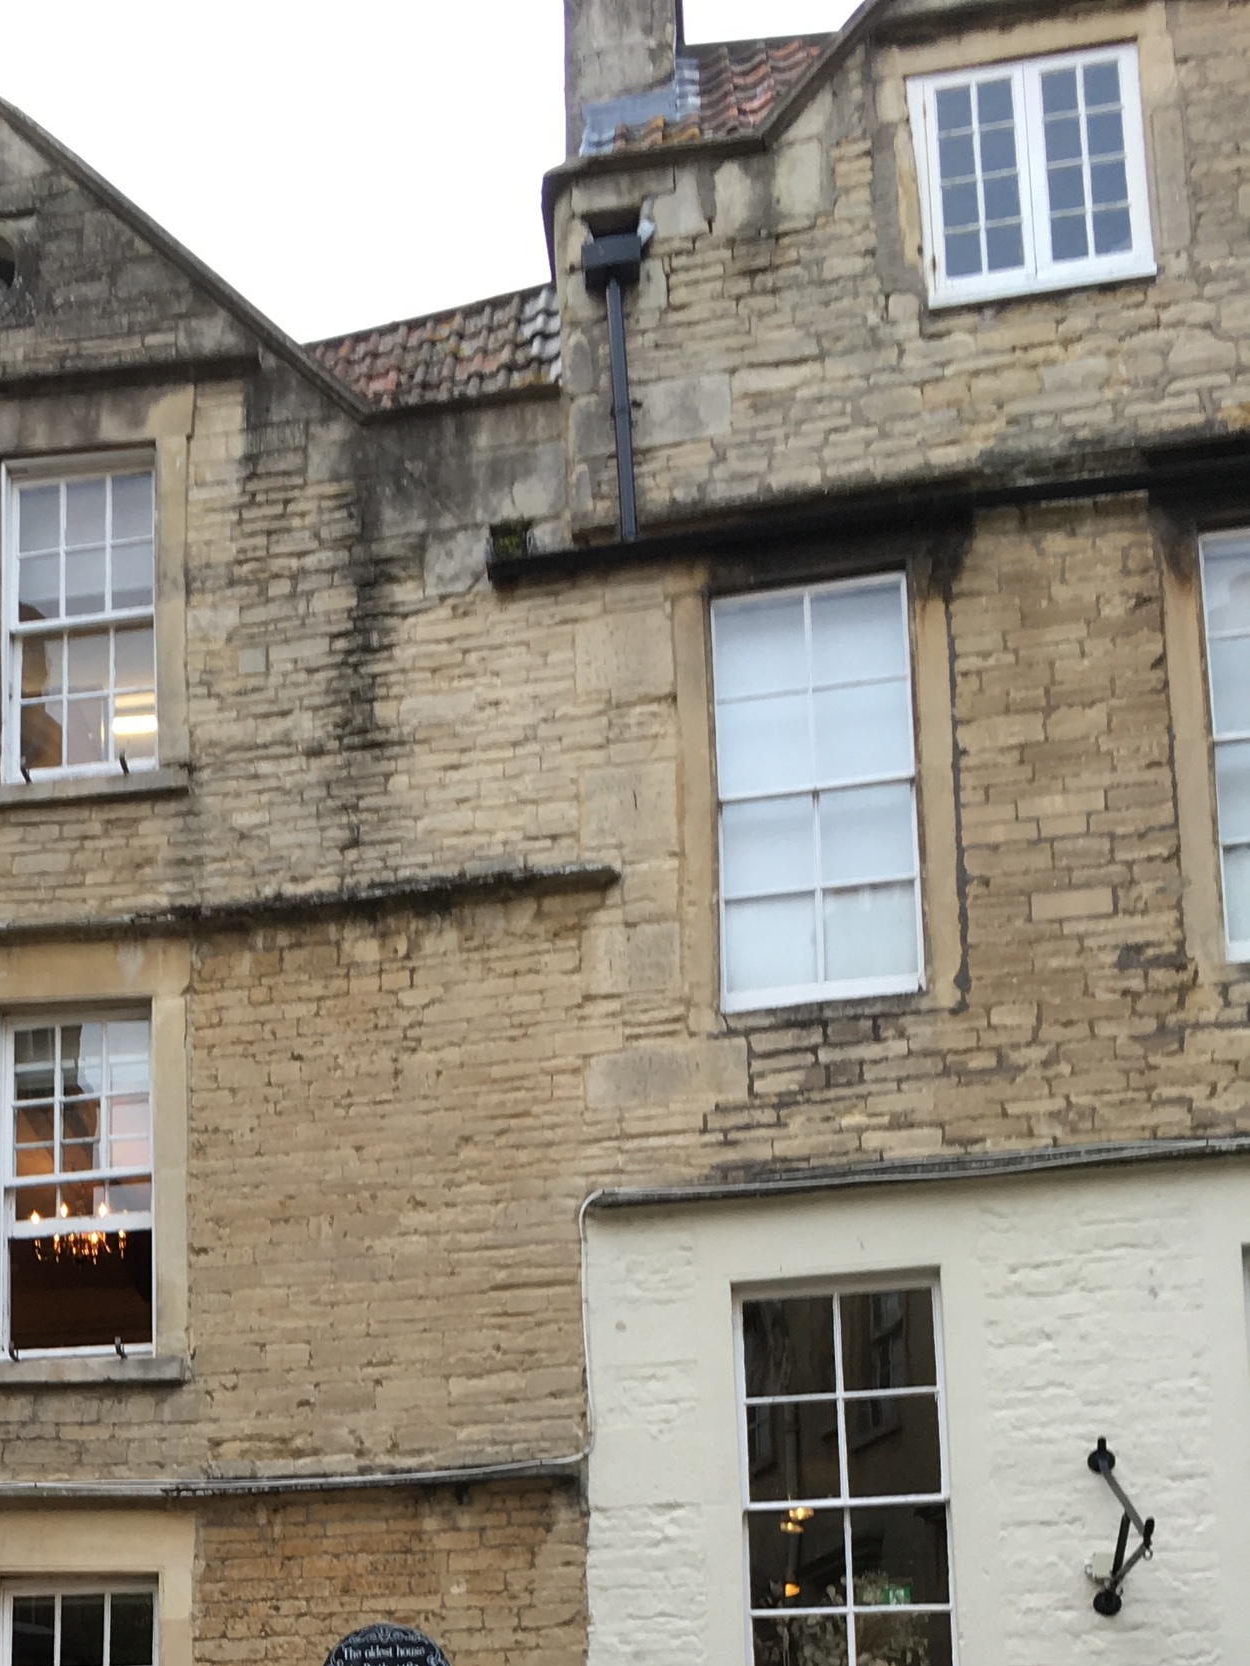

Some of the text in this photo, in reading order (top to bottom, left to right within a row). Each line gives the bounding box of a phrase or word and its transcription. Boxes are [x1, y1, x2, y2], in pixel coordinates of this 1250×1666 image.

[344, 1645, 425, 1660] The oldest house
